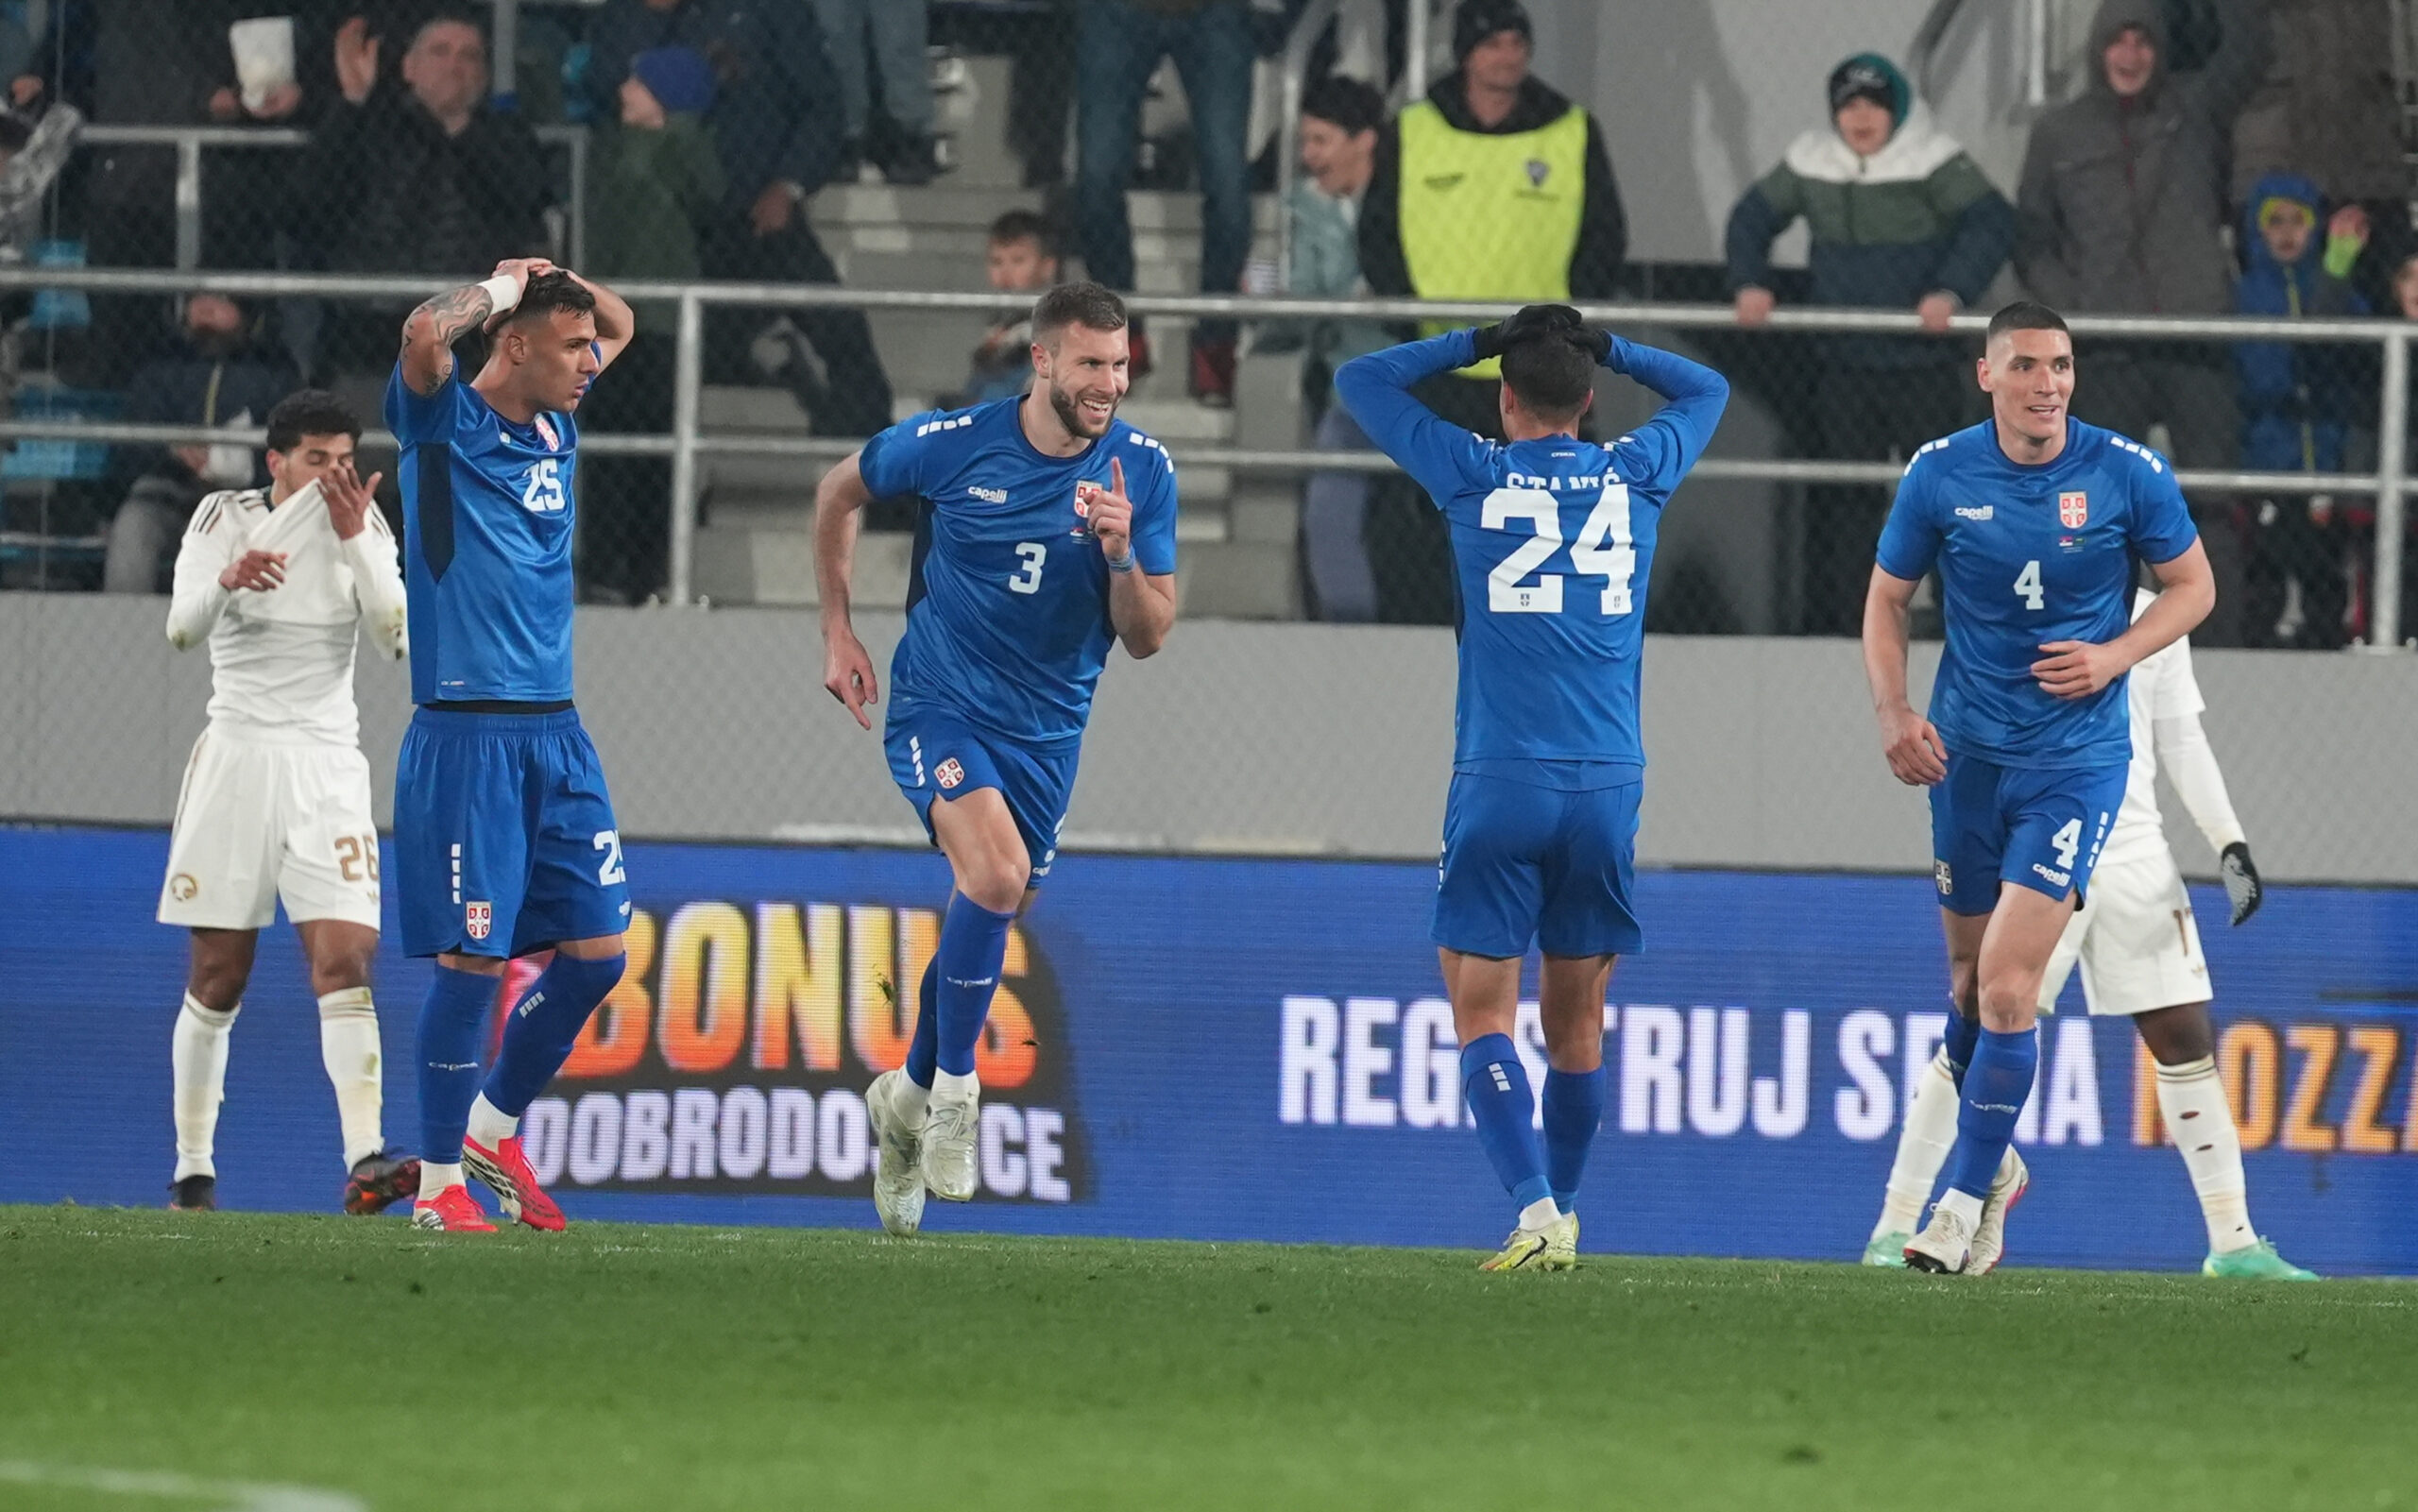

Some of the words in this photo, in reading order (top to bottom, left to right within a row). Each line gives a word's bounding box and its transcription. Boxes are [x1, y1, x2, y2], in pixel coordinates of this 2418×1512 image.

[521, 458, 565, 511] 25
[1009, 542, 1047, 595] 3
[1481, 483, 1636, 615] 24
[2013, 560, 2044, 610] 4
[333, 836, 380, 882] 26
[2052, 818, 2083, 870] 4
[2172, 907, 2192, 958] 1
[1279, 996, 1811, 1137] REGRUJ
[2131, 1020, 2418, 1152] OZZ
[522, 1087, 1071, 1202] DOBRODOCE
